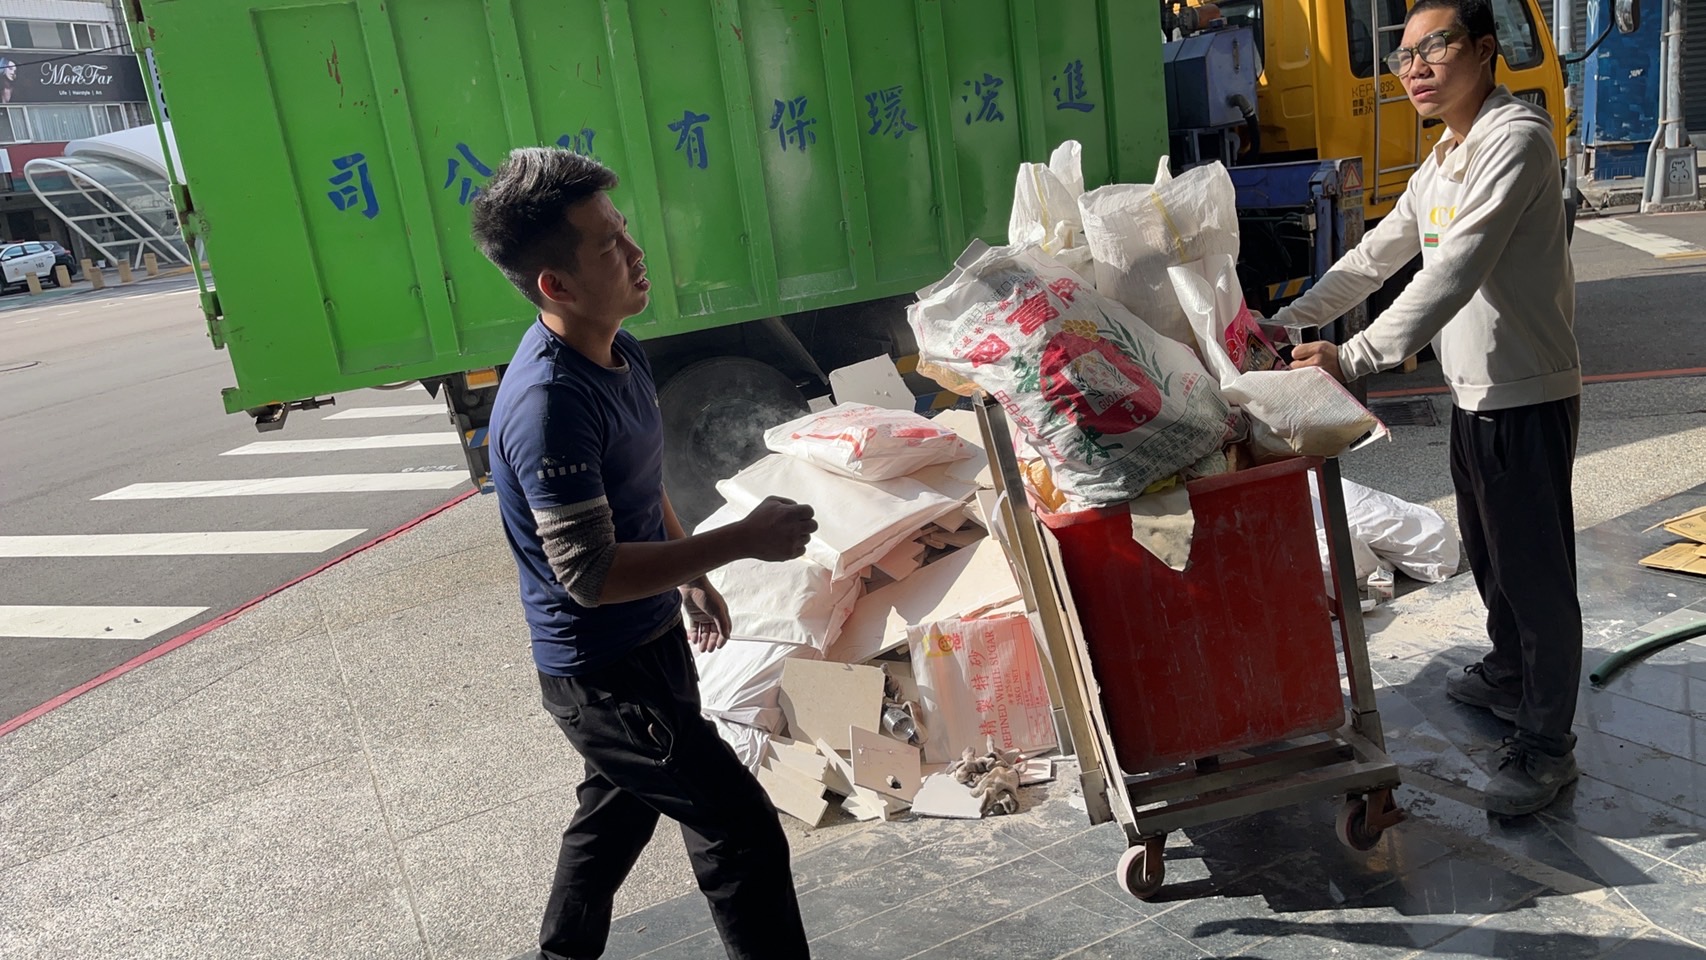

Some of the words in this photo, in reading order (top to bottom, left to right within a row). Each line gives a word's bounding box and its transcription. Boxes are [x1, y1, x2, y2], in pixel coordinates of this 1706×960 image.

[984, 631, 1000, 667] SUGAR
[991, 669, 1006, 703] WHITE
[997, 703, 1014, 749] REFINED
